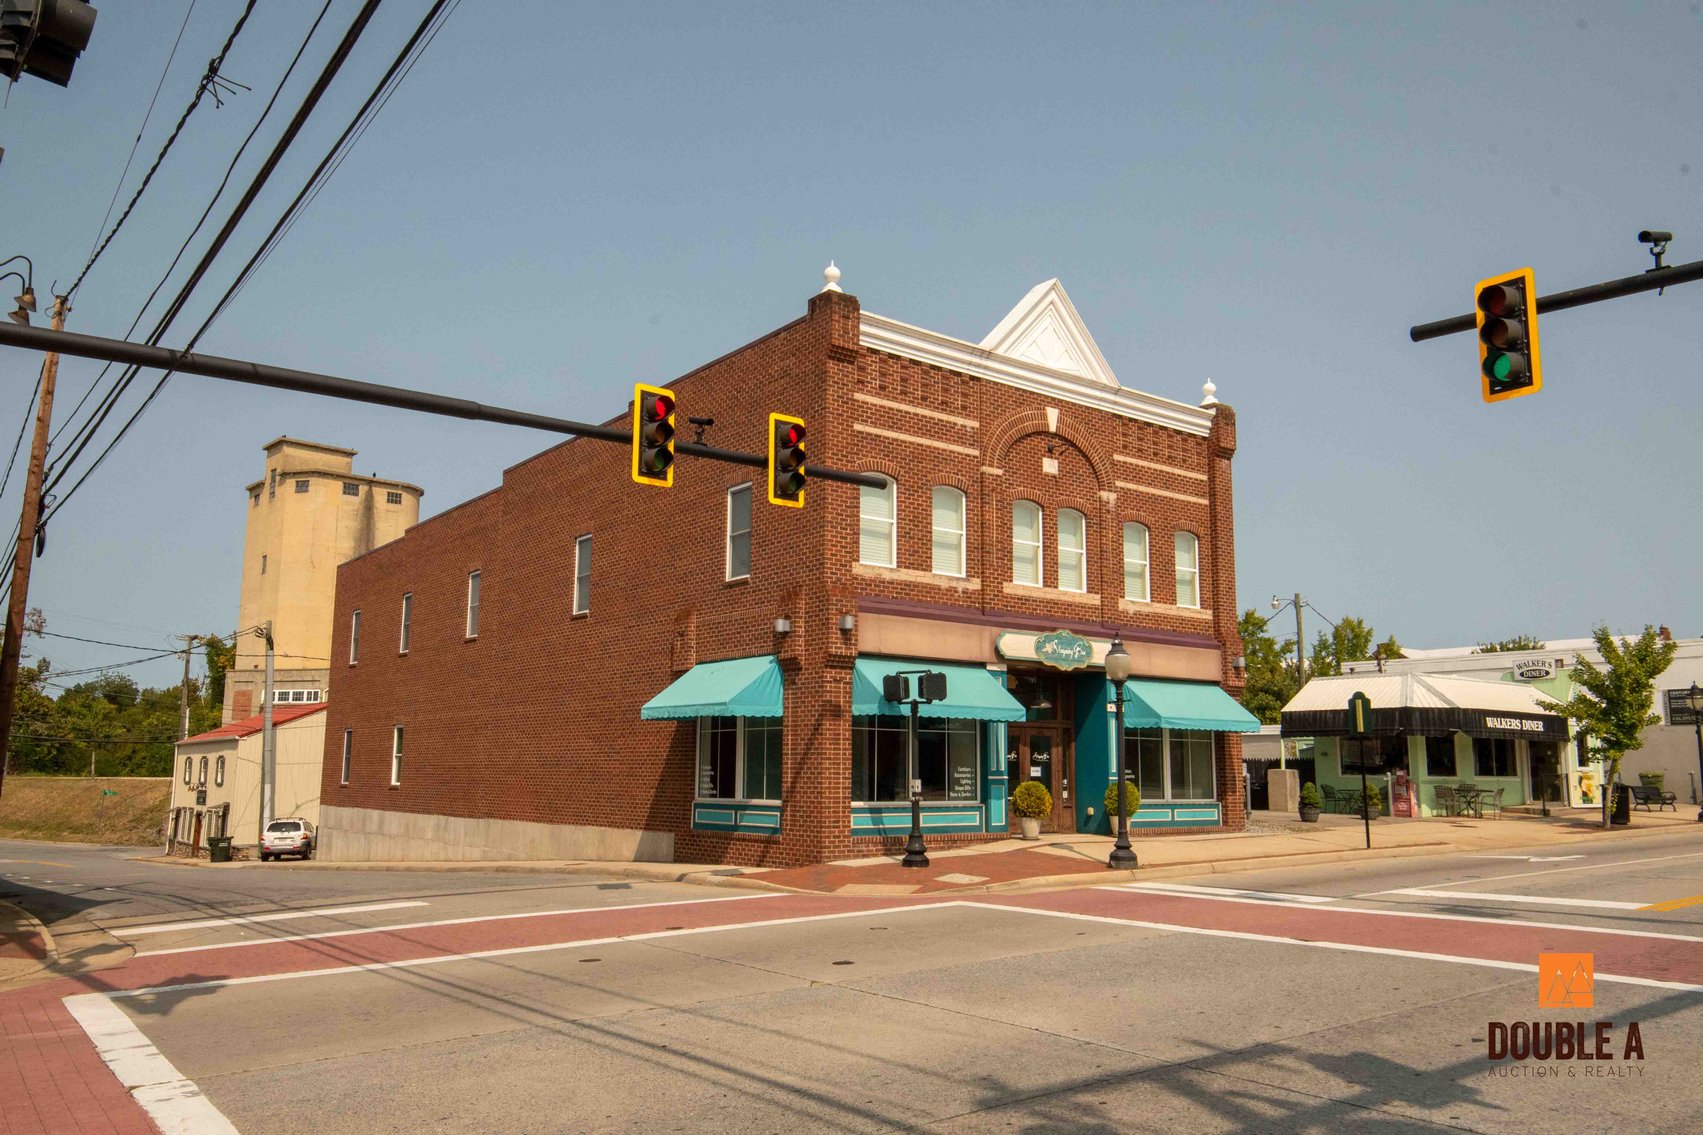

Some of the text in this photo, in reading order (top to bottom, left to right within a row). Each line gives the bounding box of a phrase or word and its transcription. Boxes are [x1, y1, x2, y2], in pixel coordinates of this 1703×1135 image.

[1515, 660, 1553, 670] WALKER'S
[1523, 670, 1546, 678] DINER
[1486, 717, 1544, 732] WALKERS DINER
